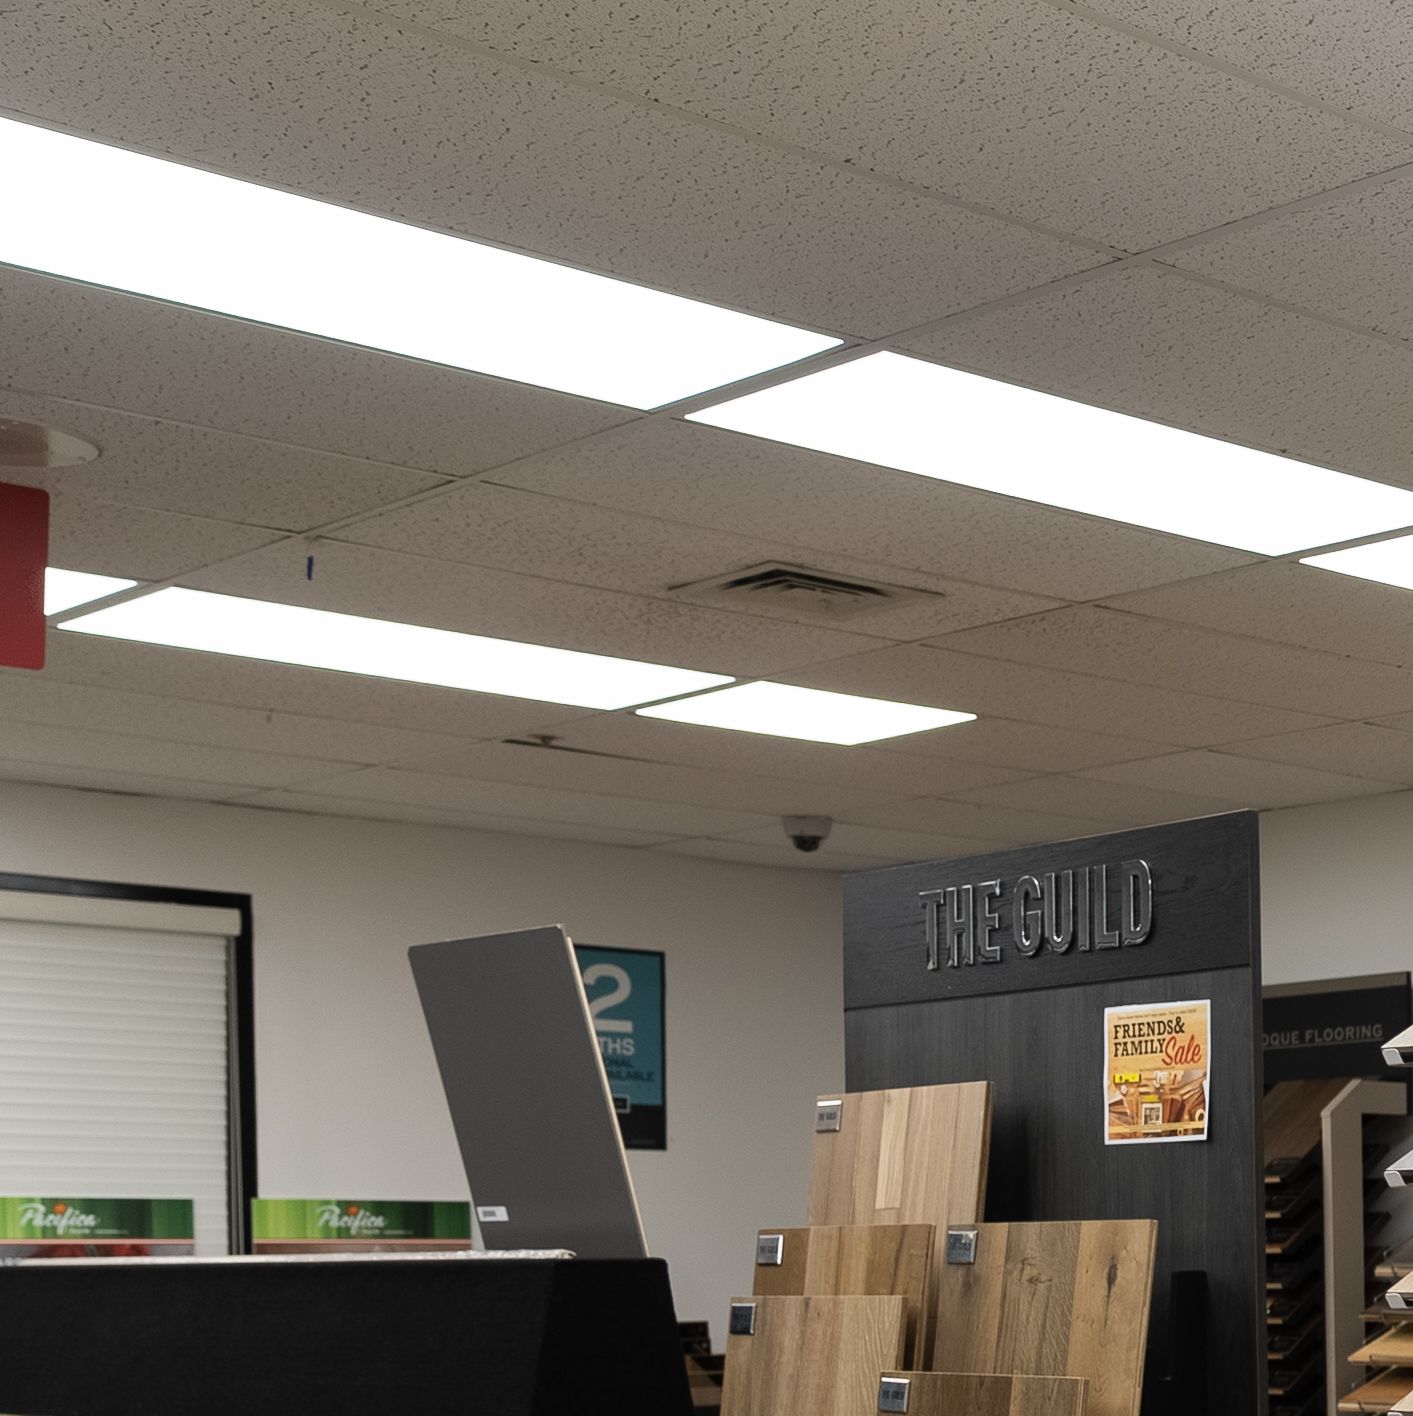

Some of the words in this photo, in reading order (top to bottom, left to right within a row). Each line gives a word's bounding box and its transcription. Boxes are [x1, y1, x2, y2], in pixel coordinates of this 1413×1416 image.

[919, 879, 1003, 971] THE
[1013, 858, 1154, 957] GUILD
[600, 1037, 634, 1056] THS
[1114, 1038, 1166, 1057] FAMILY
[1162, 1034, 1202, 1066] Sale
[1262, 1031, 1299, 1046] OQUE
[1305, 1024, 1383, 1042] FLOORING
[17, 1203, 98, 1235] Pacifica
[316, 1205, 385, 1235] Pacifica
